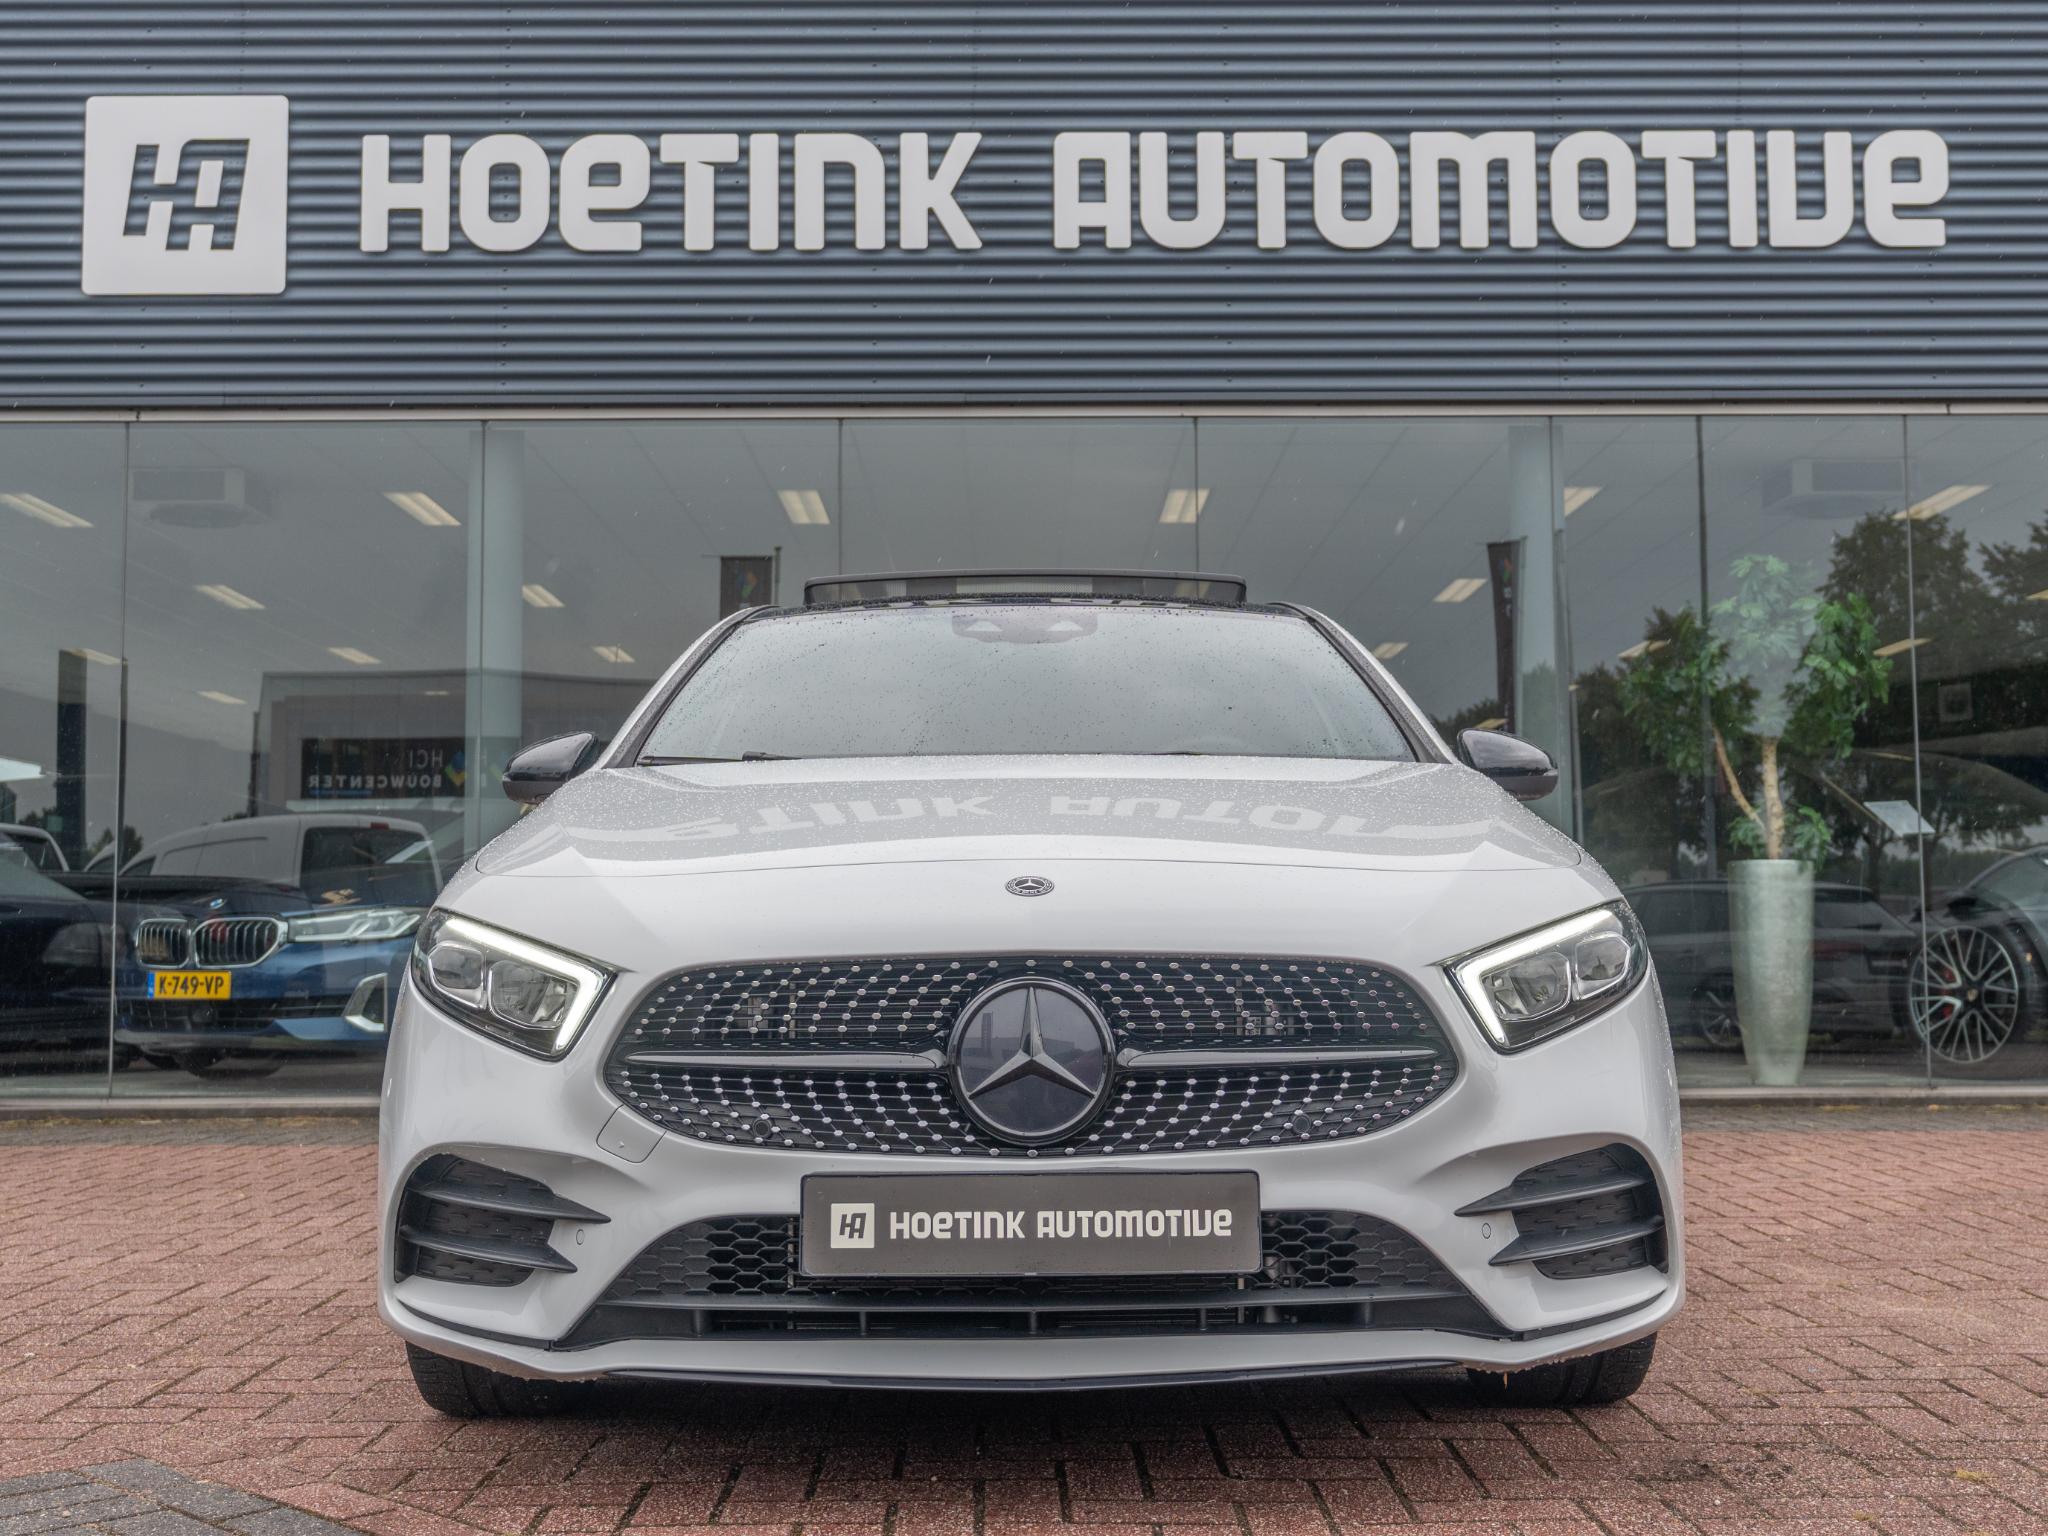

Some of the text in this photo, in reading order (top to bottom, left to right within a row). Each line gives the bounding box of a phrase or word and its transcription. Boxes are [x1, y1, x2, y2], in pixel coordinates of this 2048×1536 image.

[1053, 130, 1950, 248] AUTOMOTIVE
[158, 975, 224, 995] K-749-VP
[1036, 1208, 1232, 1238] AUTOMOTIVE
